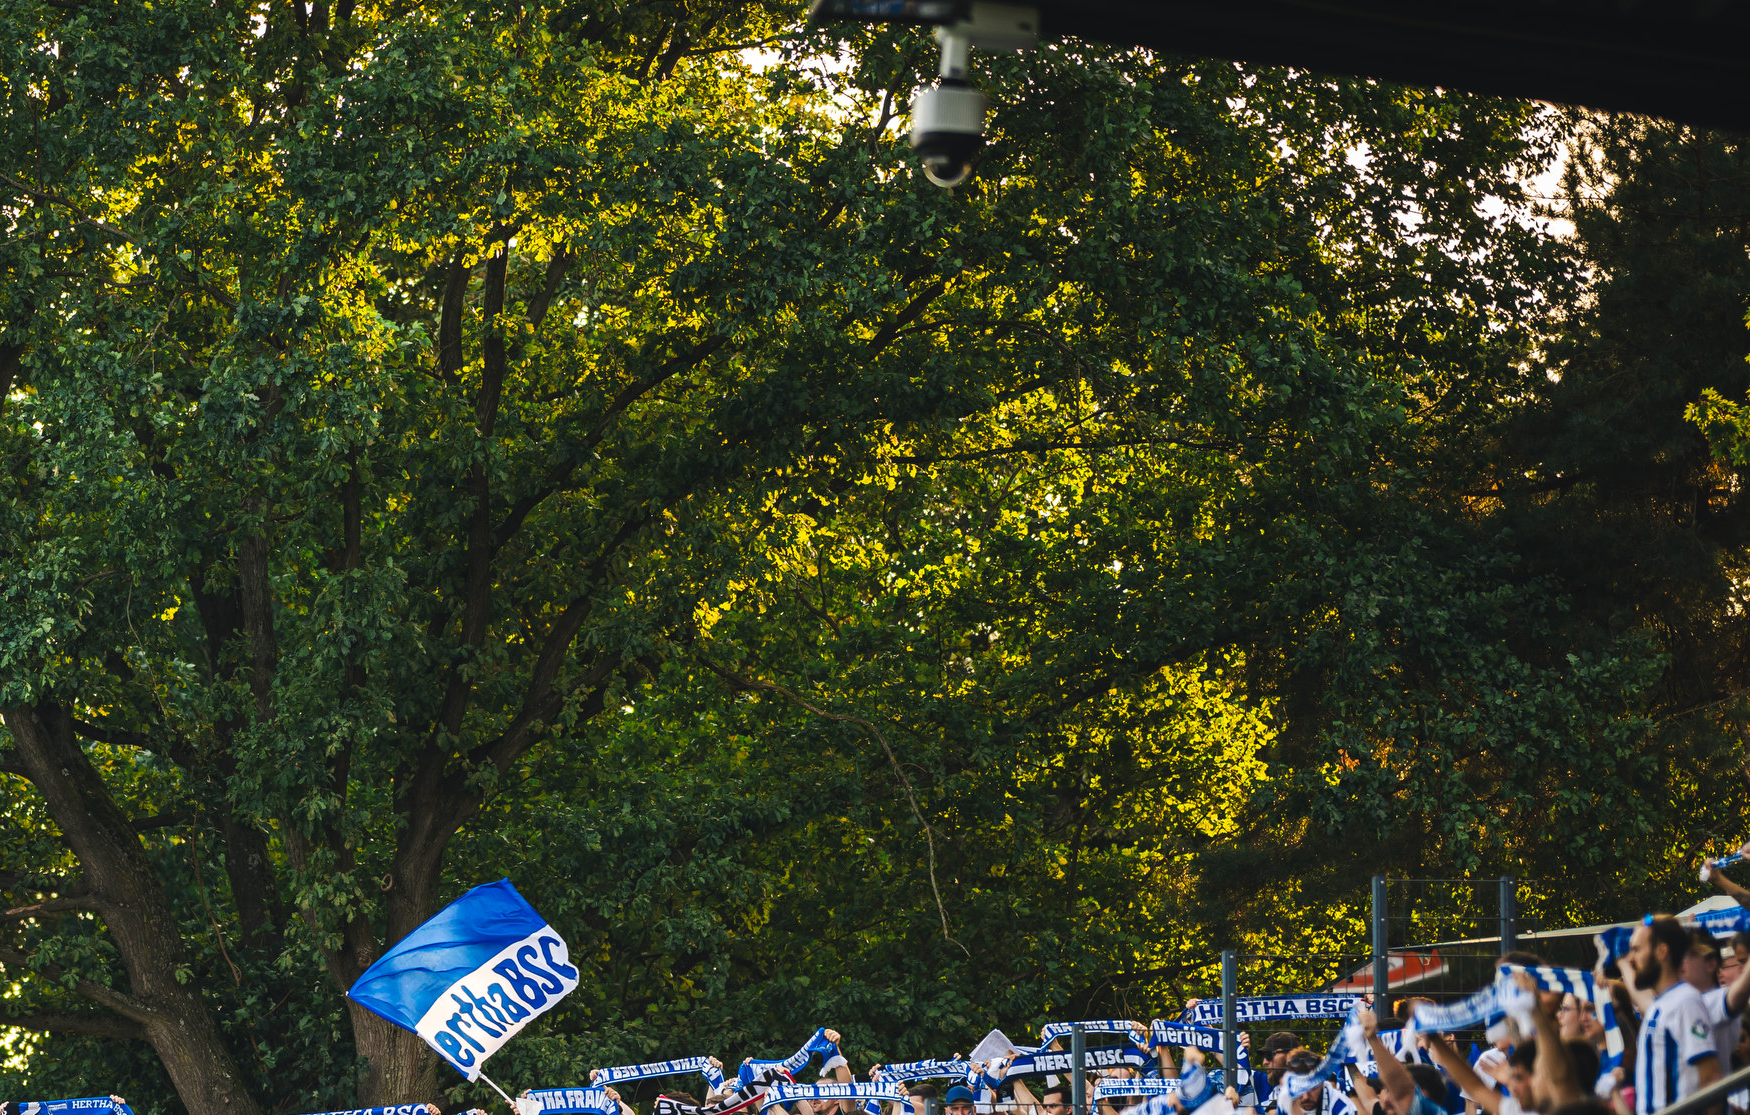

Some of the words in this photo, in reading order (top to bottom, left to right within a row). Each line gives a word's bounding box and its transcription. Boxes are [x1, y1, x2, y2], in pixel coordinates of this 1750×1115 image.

[433, 984, 531, 1068] ertha
[492, 935, 578, 1010] BSC
[1306, 997, 1354, 1014] BSC
[1156, 1020, 1213, 1047] Hertha
[1034, 1050, 1094, 1071] HERTA
[1095, 1048, 1125, 1066] BSC
[72, 1099, 114, 1109] HERTHA
